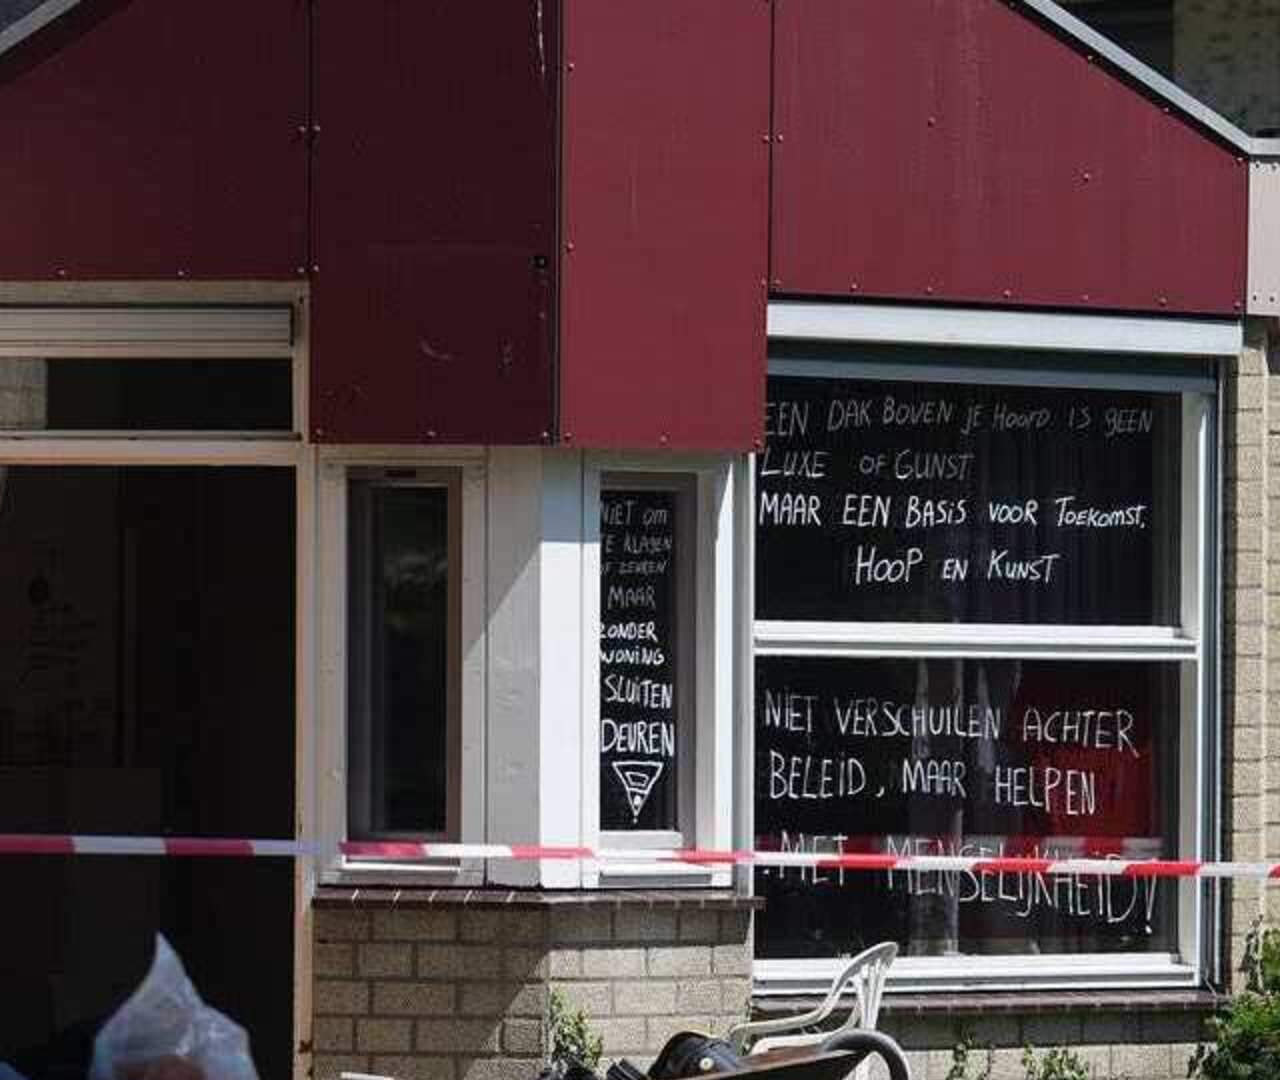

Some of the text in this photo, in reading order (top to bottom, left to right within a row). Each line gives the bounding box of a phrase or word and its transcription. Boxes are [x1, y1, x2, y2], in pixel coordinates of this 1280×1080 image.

[827, 398, 873, 432] DAK
[882, 396, 953, 425] BOVEN
[1069, 405, 1091, 430] IS
[761, 446, 975, 481] LUXE OF GUNST
[759, 490, 821, 526] MAAR
[842, 494, 891, 528] EEN
[989, 500, 1038, 526] VOOR
[855, 545, 1061, 585] HOOP EN KUNST
[602, 719, 675, 757] DEUREN
[765, 689, 1140, 758] NIET VERSCHUILEN ACHTER
[902, 757, 967, 799] MAAR
[994, 766, 1095, 816] HELPEN
[780, 829, 849, 886] MET
